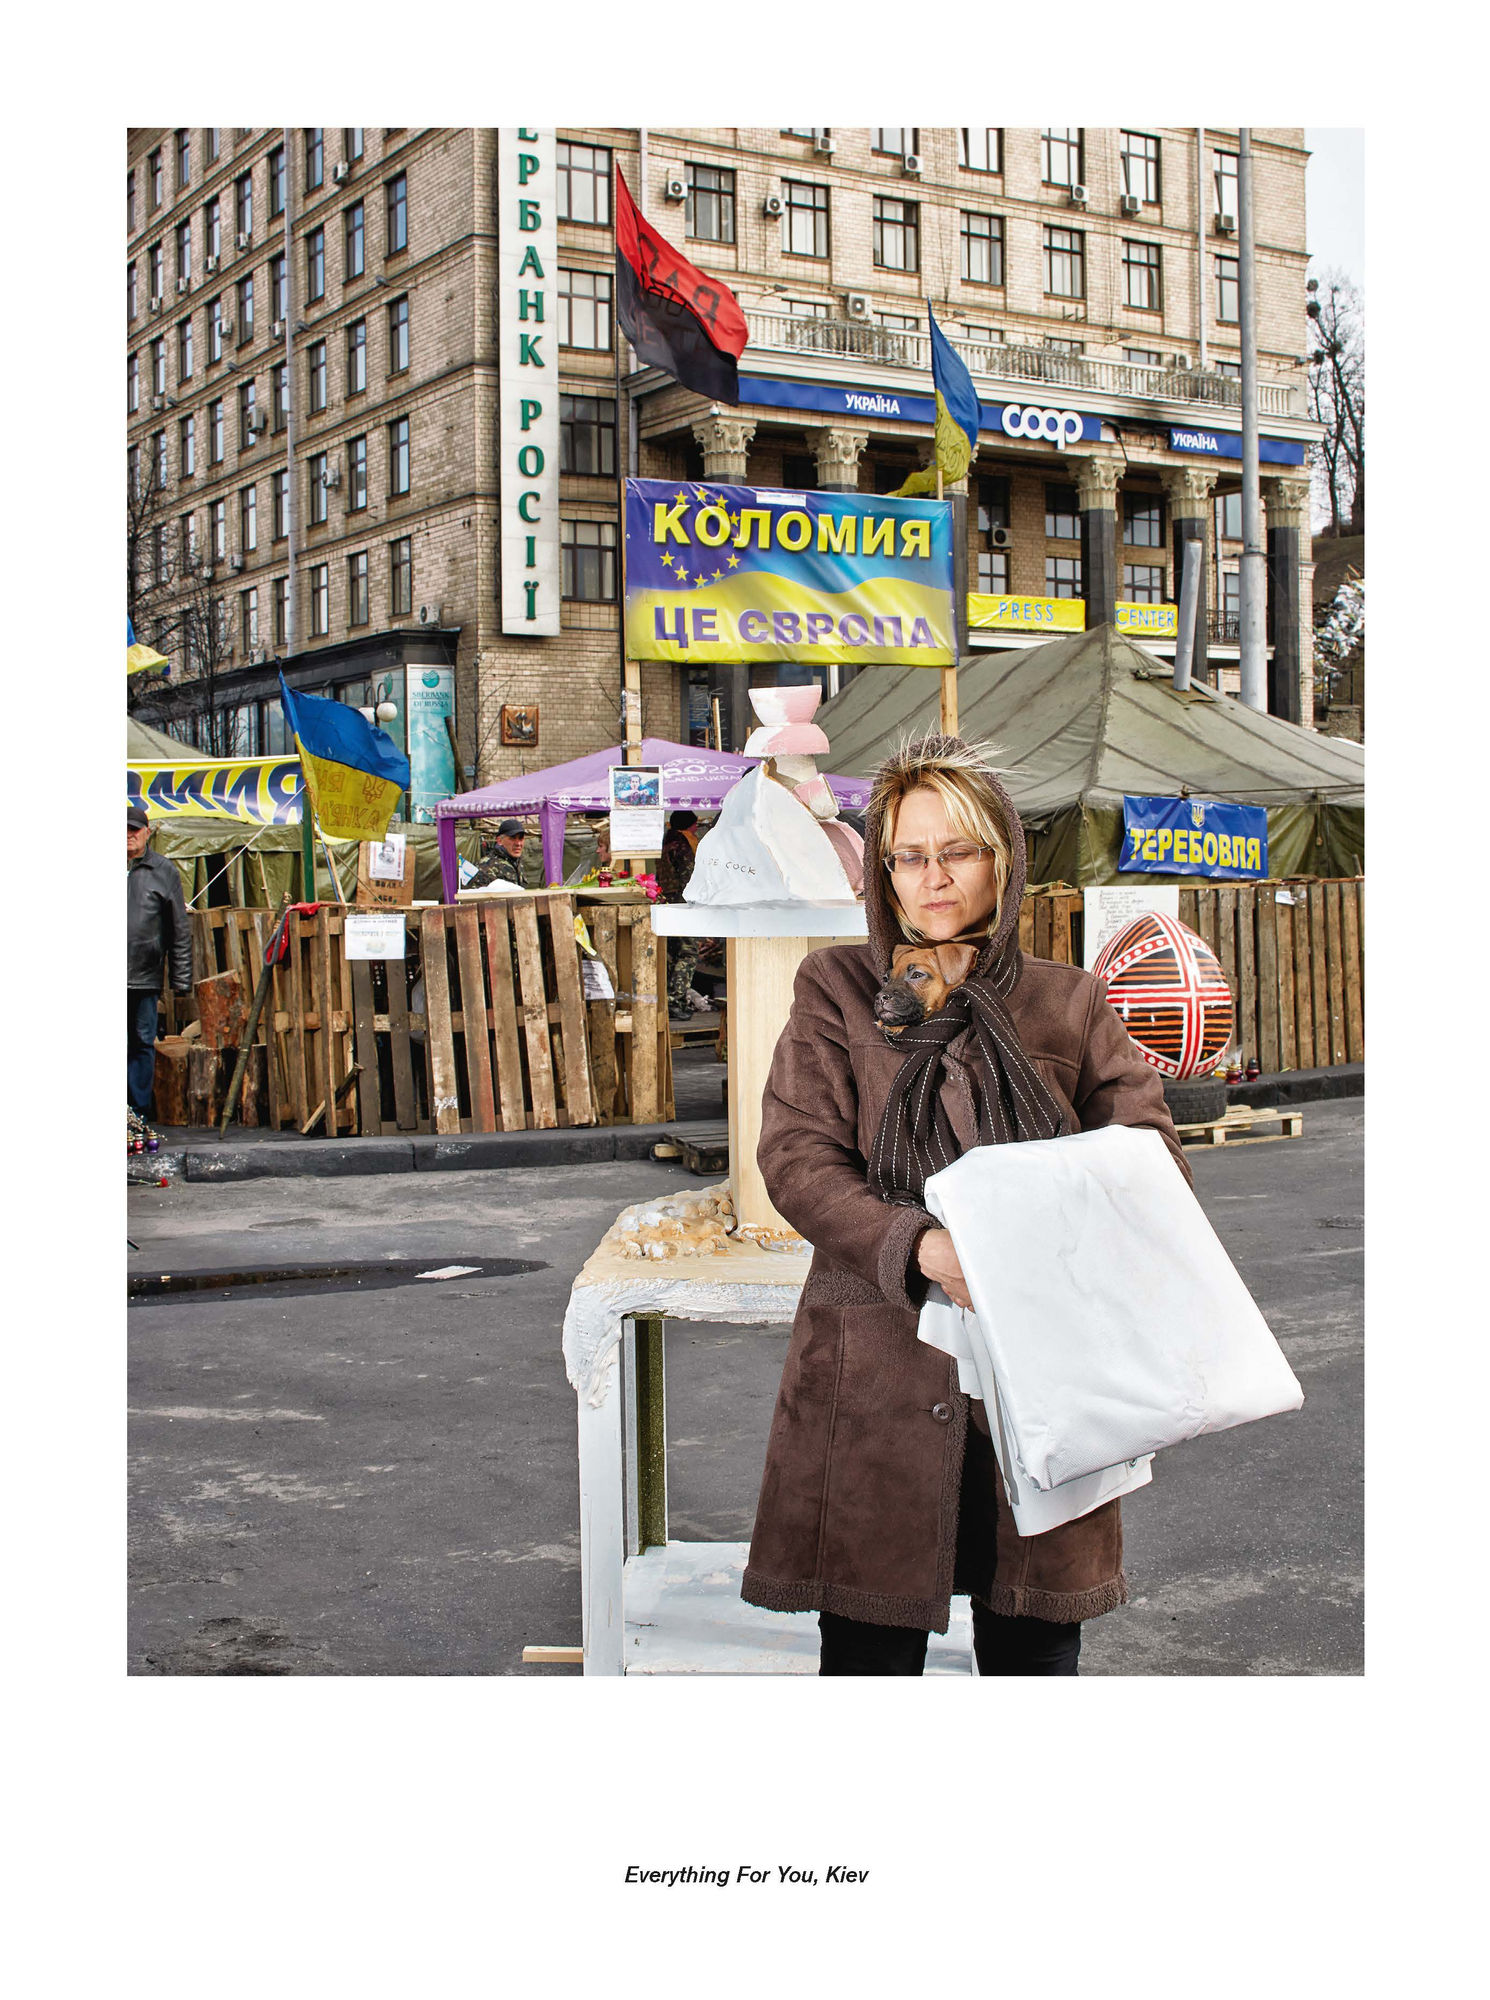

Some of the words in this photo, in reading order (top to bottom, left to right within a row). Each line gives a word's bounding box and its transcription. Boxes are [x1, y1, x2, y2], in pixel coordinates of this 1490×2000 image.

[845, 393, 900, 414] УКРАЇНА
[1001, 403, 1083, 451] coop
[1172, 430, 1218, 451] УКРАЇНА
[518, 399, 545, 620] РОСІЇ
[653, 503, 931, 558] КОЛОМИЯ
[654, 606, 720, 649] ЦЕ
[738, 609, 938, 649] ЄВРОПА
[999, 602, 1054, 621] PRESS
[1115, 608, 1175, 627] CENTER
[1129, 827, 1261, 870] ТЕРЕБОВЛЯ
[725, 861, 756, 875] COCK
